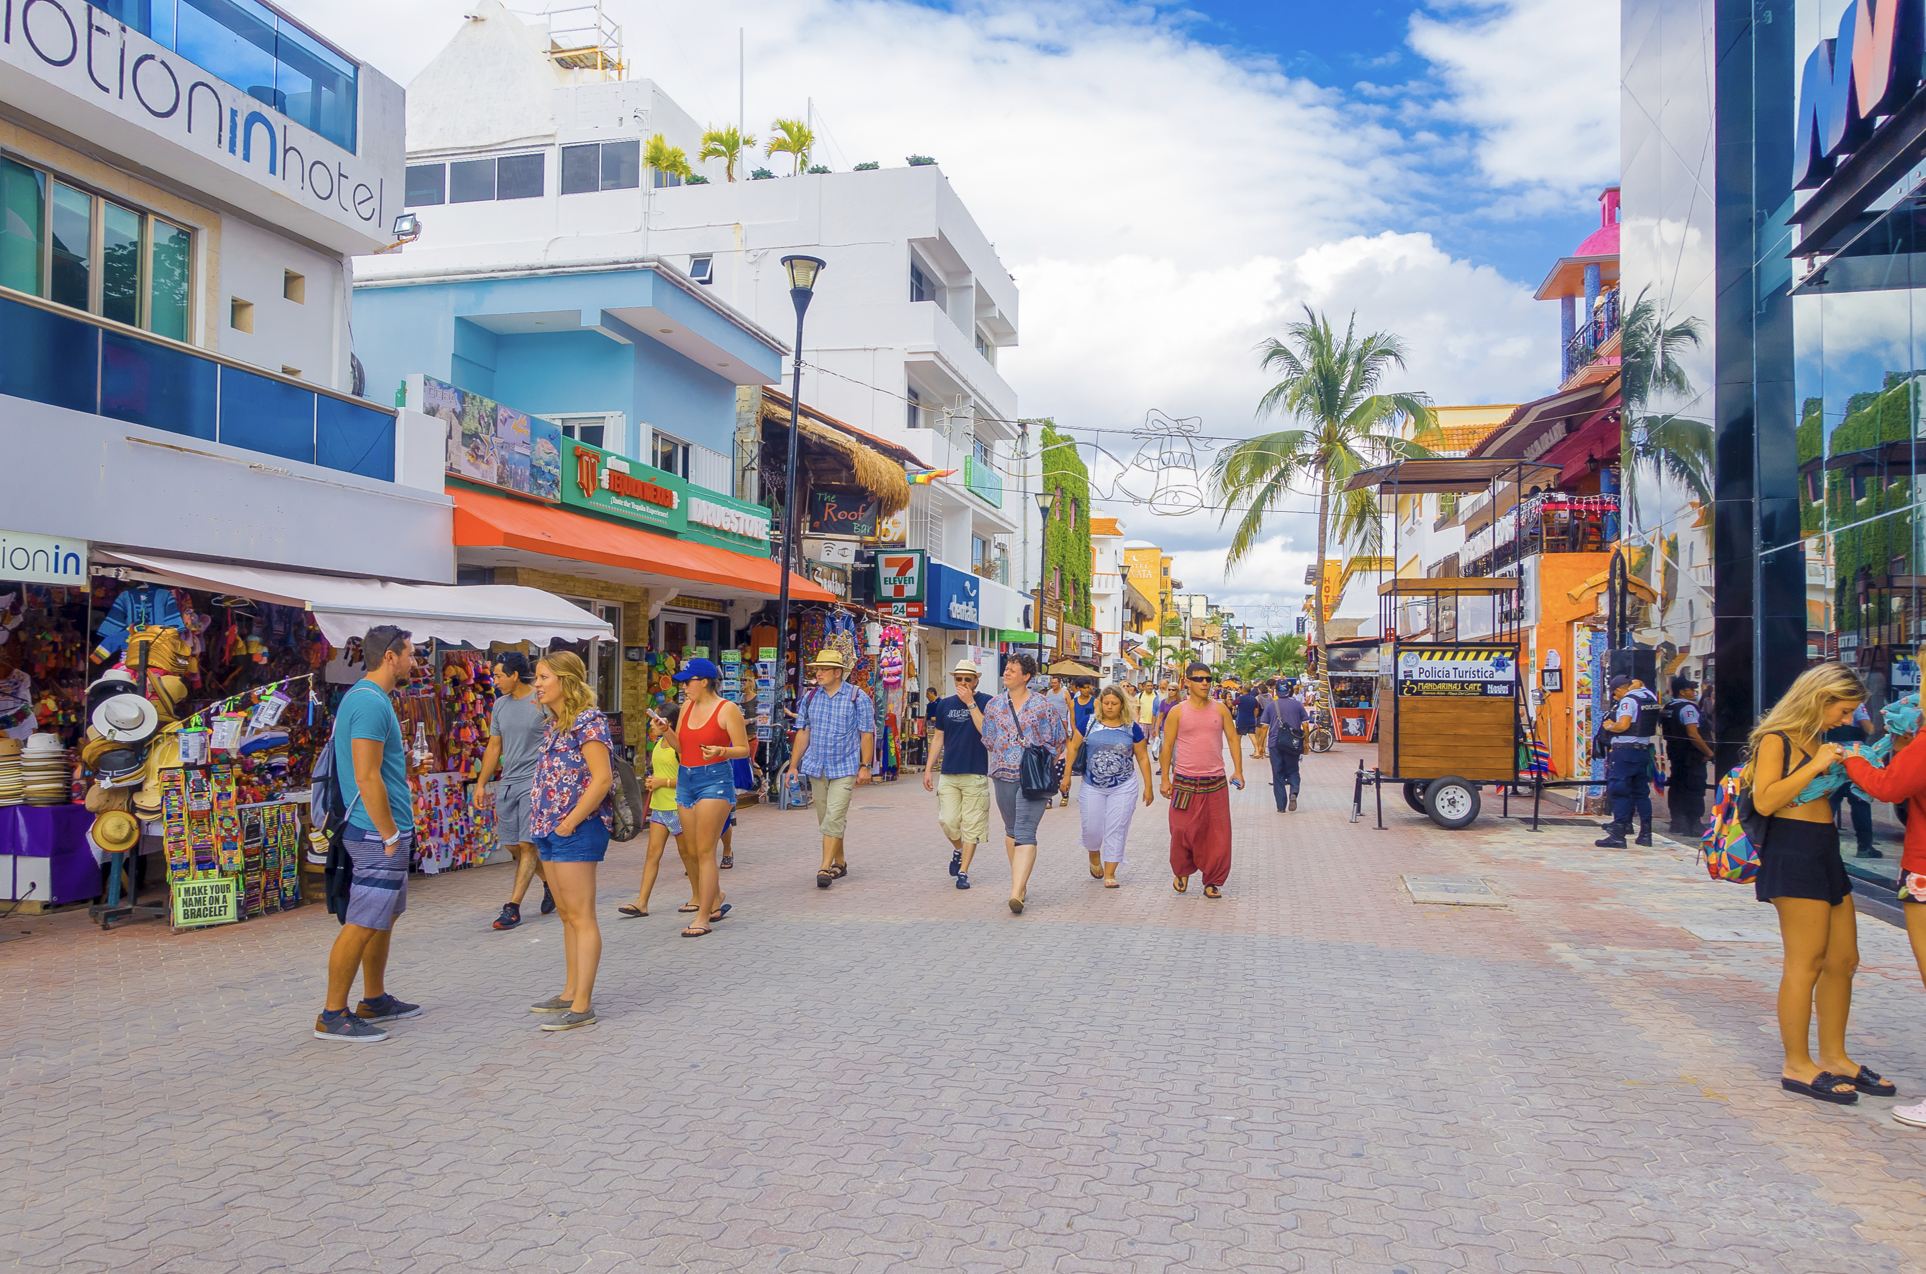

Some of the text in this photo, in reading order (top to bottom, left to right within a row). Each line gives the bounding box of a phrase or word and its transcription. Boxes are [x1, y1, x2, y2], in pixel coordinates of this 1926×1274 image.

[816, 492, 837, 502] The
[688, 497, 770, 540] DRUGSTORE
[823, 502, 866, 522] Roof
[884, 556, 914, 597] 7
[1323, 576, 1331, 622] HOTEL
[893, 605, 906, 615] 24
[1418, 667, 1495, 679] Policía Turística
[177, 884, 231, 897] I MAKE YOUR
[182, 895, 228, 908] NAME ON A
[183, 905, 228, 920] BRACELET
